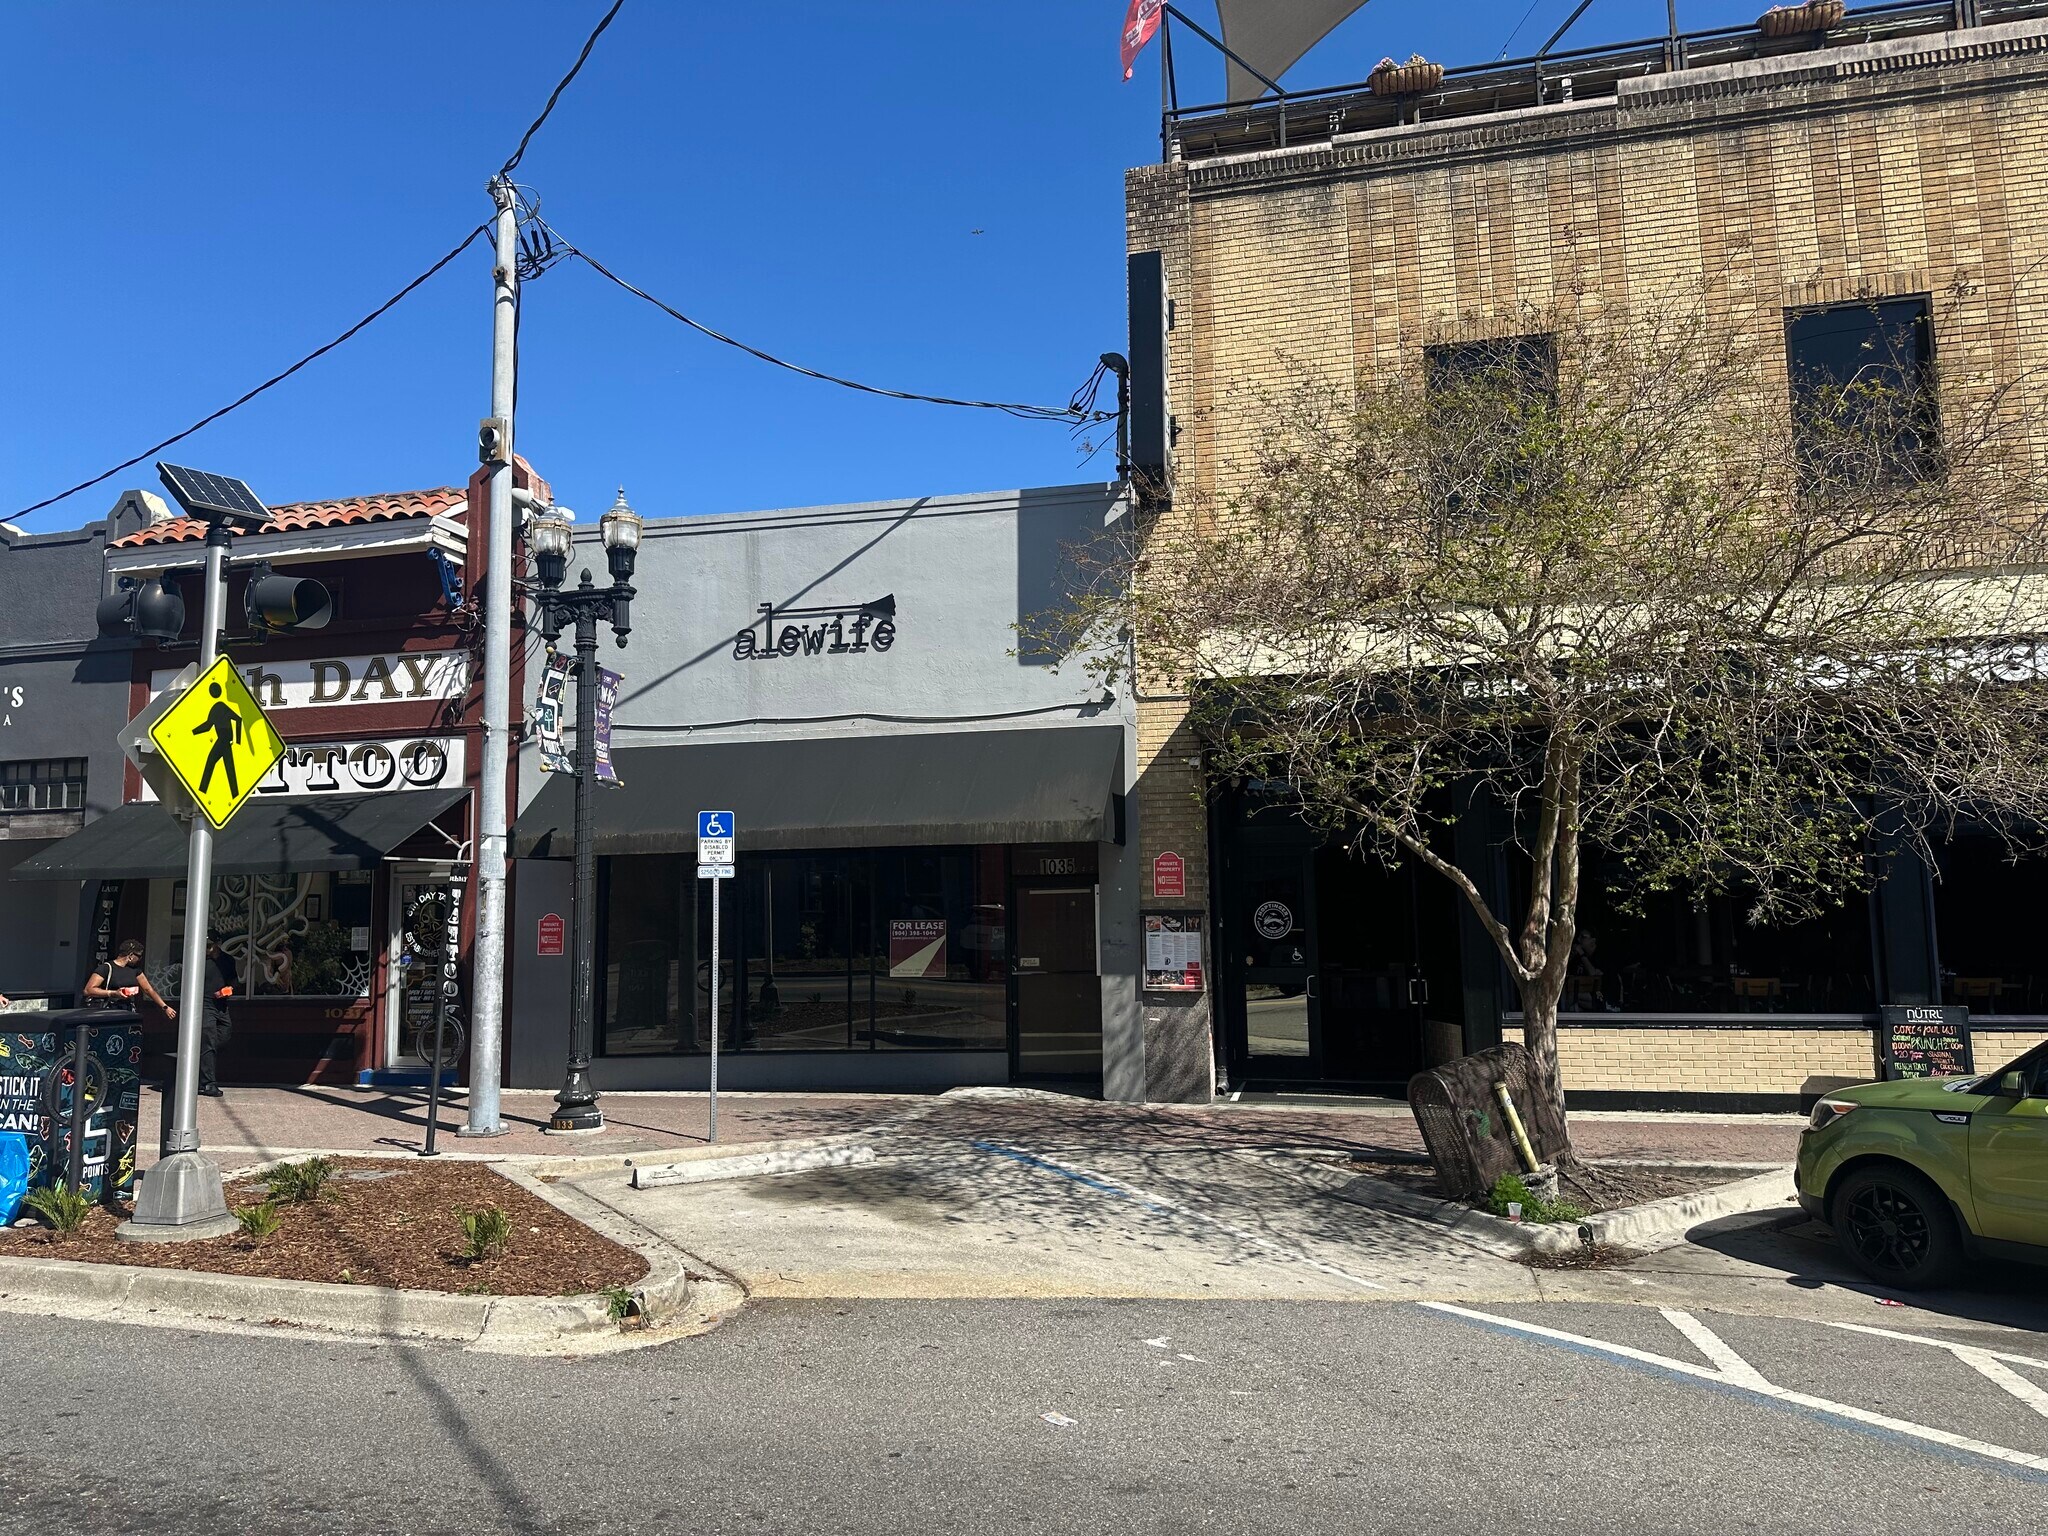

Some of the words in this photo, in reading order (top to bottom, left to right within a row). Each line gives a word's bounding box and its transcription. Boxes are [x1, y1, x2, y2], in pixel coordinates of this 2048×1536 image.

[735, 601, 896, 655] alewife
[310, 653, 442, 704] DAY
[255, 740, 448, 793] TTOO
[1042, 859, 1074, 874] 1035
[1157, 875, 1166, 885] NO
[418, 891, 437, 904] DAY
[892, 922, 912, 930] FOR
[914, 922, 944, 930] LEASE
[1910, 1036, 1944, 1050] BRUNCH
[12, 1098, 36, 1111] THE
[553, 1120, 573, 1129] 1033
[82, 1163, 109, 1178] POINTS
